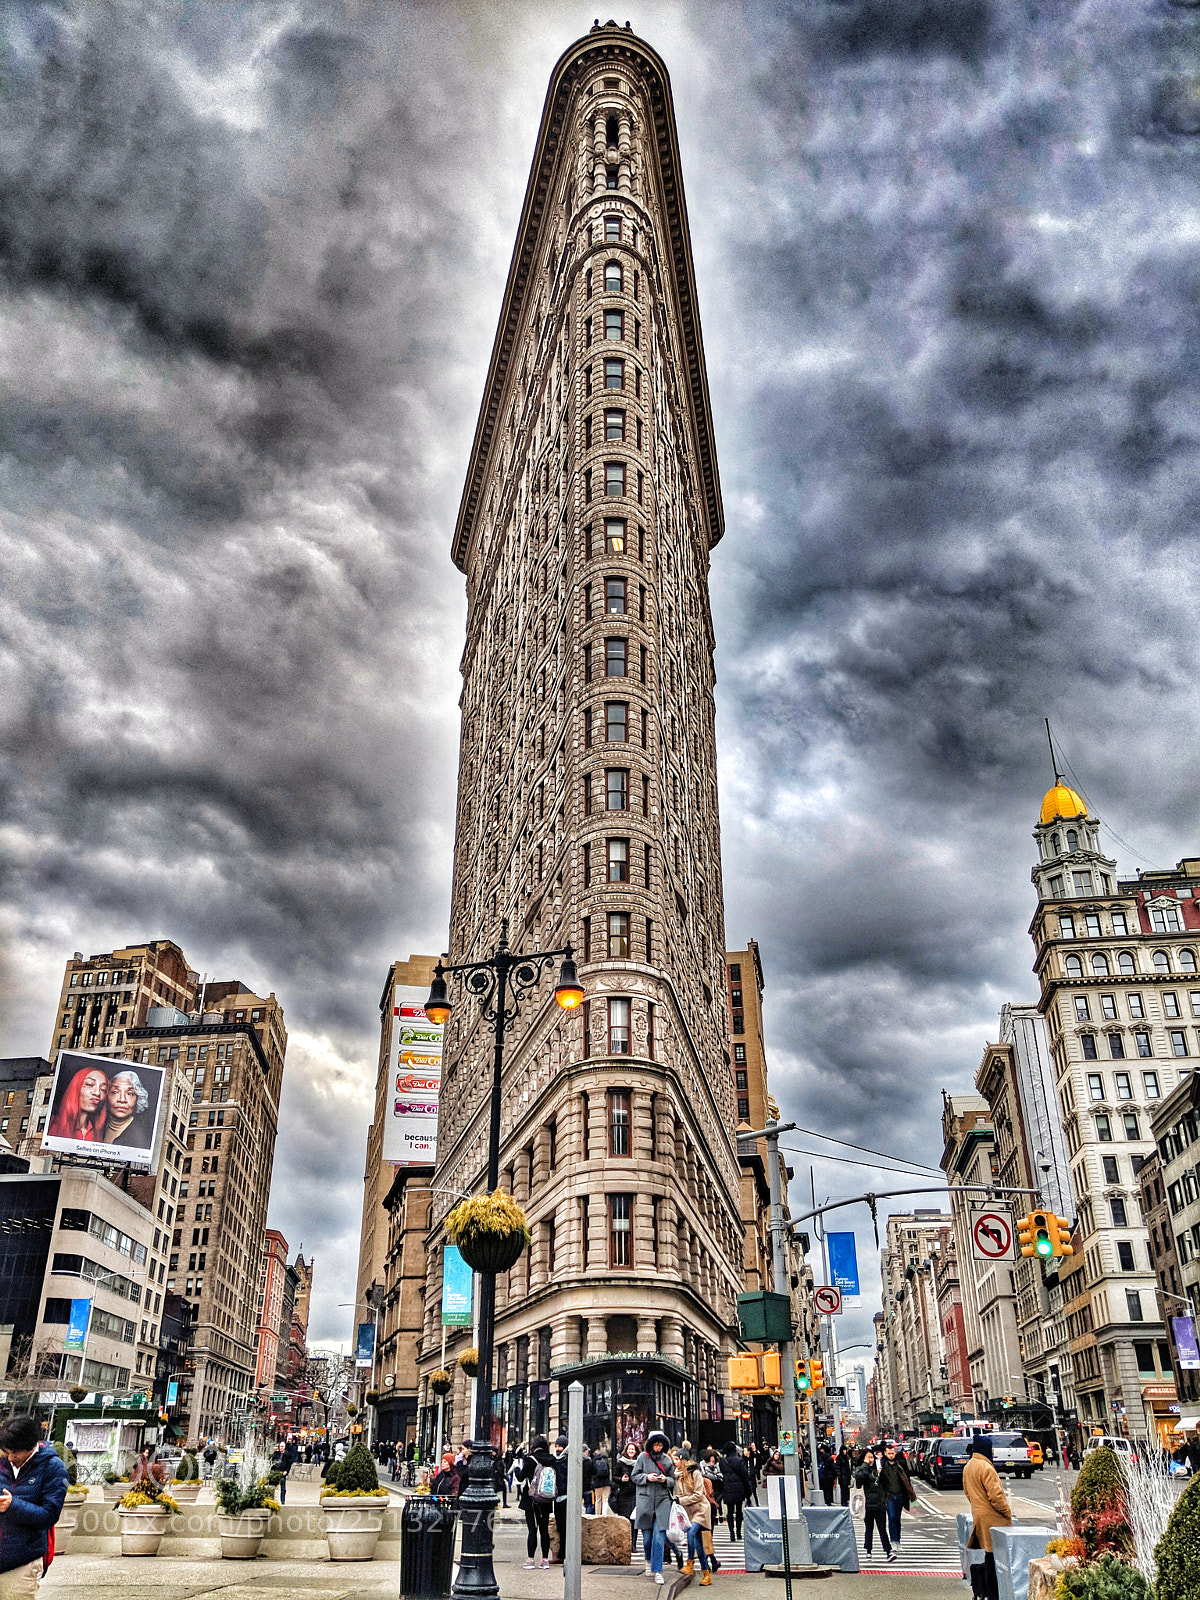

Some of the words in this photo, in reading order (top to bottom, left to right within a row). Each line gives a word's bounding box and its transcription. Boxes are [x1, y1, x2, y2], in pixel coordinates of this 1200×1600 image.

[404, 1133, 437, 1141] because
[409, 1141, 413, 1149] I
[75, 1144, 92, 1153] Selfies
[99, 1147, 117, 1156] iPhone
[811, 1532, 840, 1540] Partnership
